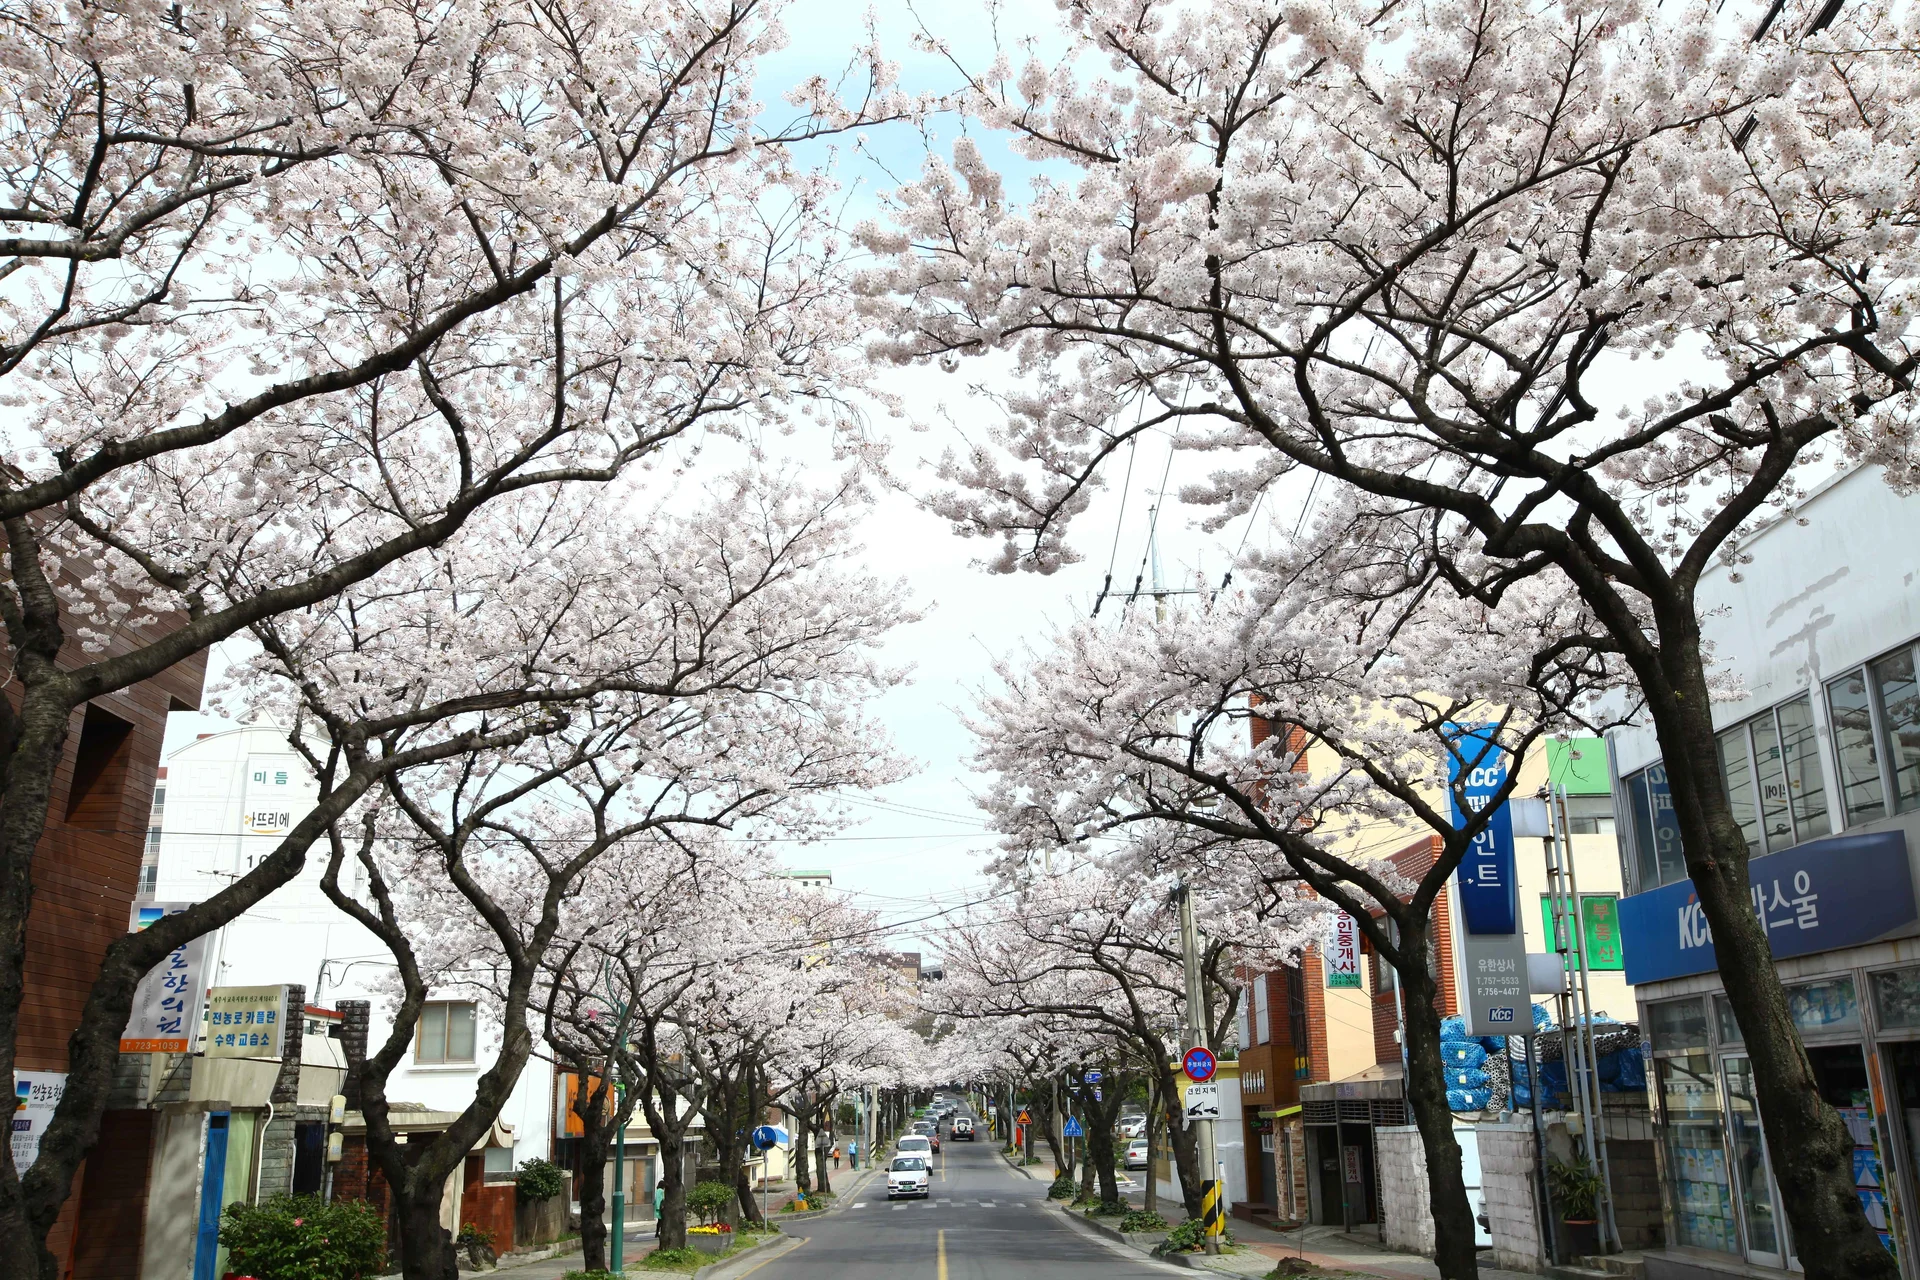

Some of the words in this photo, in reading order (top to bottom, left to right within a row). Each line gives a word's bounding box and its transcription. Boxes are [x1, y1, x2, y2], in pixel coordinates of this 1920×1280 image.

[1593, 904, 1615, 962] 부동산
[1478, 959, 1515, 972] 유한상사
[213, 1012, 242, 1025] 전농로
[246, 1011, 276, 1024] 카플란
[1491, 1007, 1512, 1021] KCC
[215, 1034, 235, 1047] 수학
[239, 1033, 269, 1046] 교습소
[1187, 1060, 1212, 1068] 주정차금지
